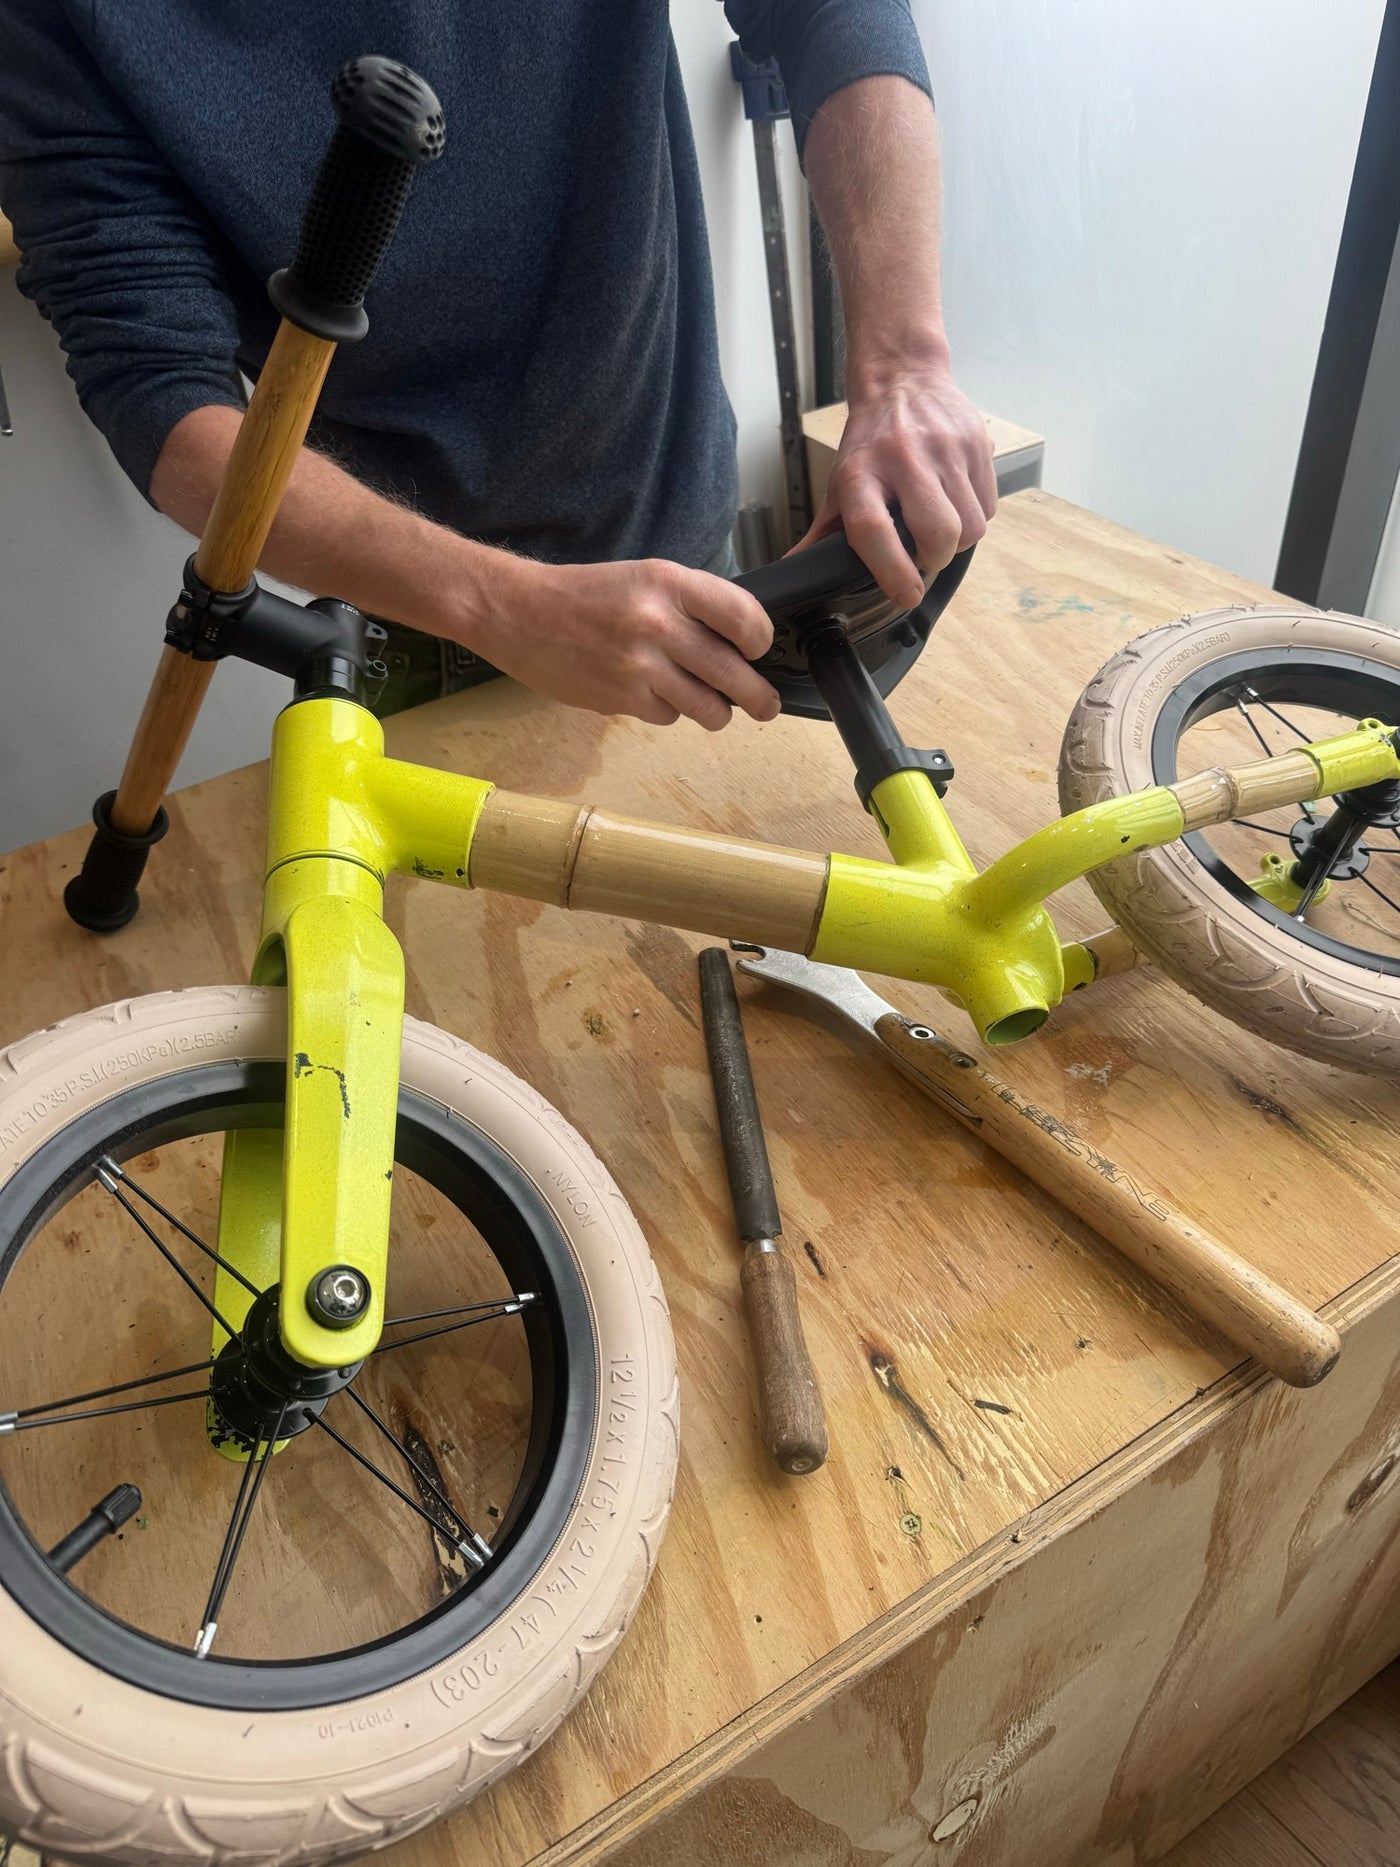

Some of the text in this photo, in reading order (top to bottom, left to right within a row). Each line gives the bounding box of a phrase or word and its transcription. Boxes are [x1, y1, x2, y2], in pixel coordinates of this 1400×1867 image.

[0, 1118, 27, 1151] ATE
[24, 1100, 47, 1124] TO
[43, 1086, 67, 1109] 35
[551, 1171, 597, 1228] NYLON
[590, 1451, 626, 1513] 1.75
